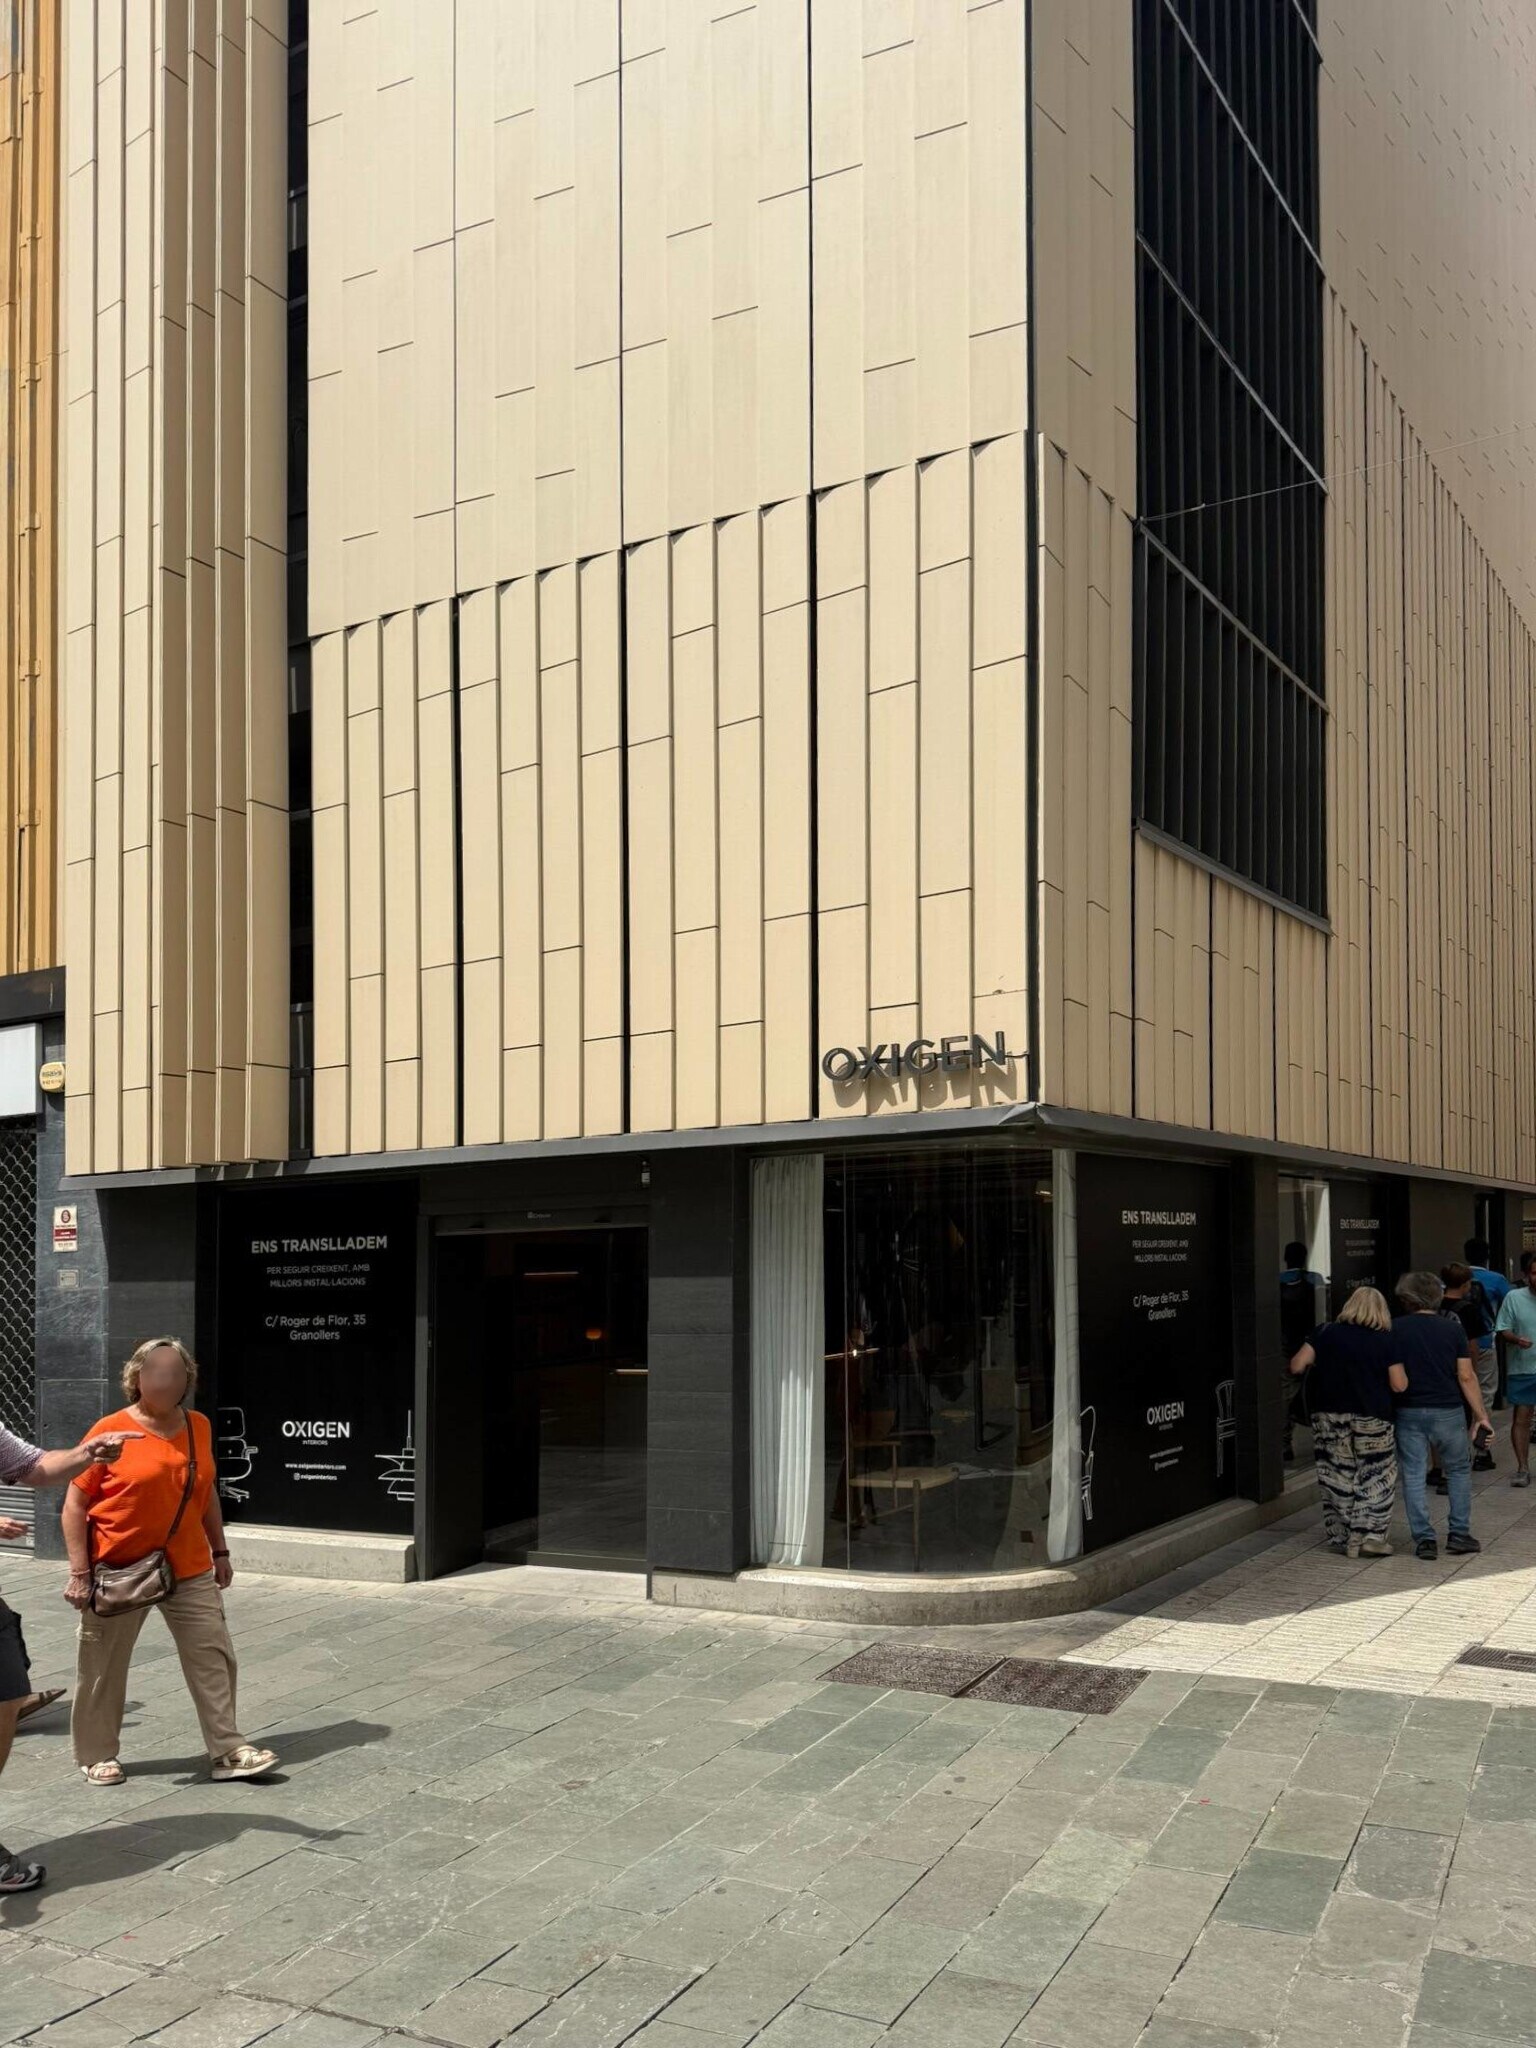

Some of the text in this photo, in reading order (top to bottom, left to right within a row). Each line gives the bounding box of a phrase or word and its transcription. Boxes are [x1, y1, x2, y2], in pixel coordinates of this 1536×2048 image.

[822, 1030, 1006, 1082] OXIGEN
[1121, 1210, 1197, 1226] ENS TRANSLLADEM
[251, 1235, 388, 1254] ENS TRANSLLADEM
[266, 1266, 281, 1274] PER
[283, 1265, 310, 1274] SEGUIR
[352, 1263, 371, 1272] AMB
[270, 1279, 302, 1287] MILLORS
[1160, 1292, 1168, 1304] de
[280, 1316, 310, 1328] Roger
[312, 1315, 326, 1326] de
[328, 1314, 351, 1326] Flor,
[353, 1314, 366, 1325] 35
[289, 1329, 340, 1341] Granollers
[1146, 1400, 1185, 1426] OXIGEN
[282, 1420, 350, 1438] OXIGEN
